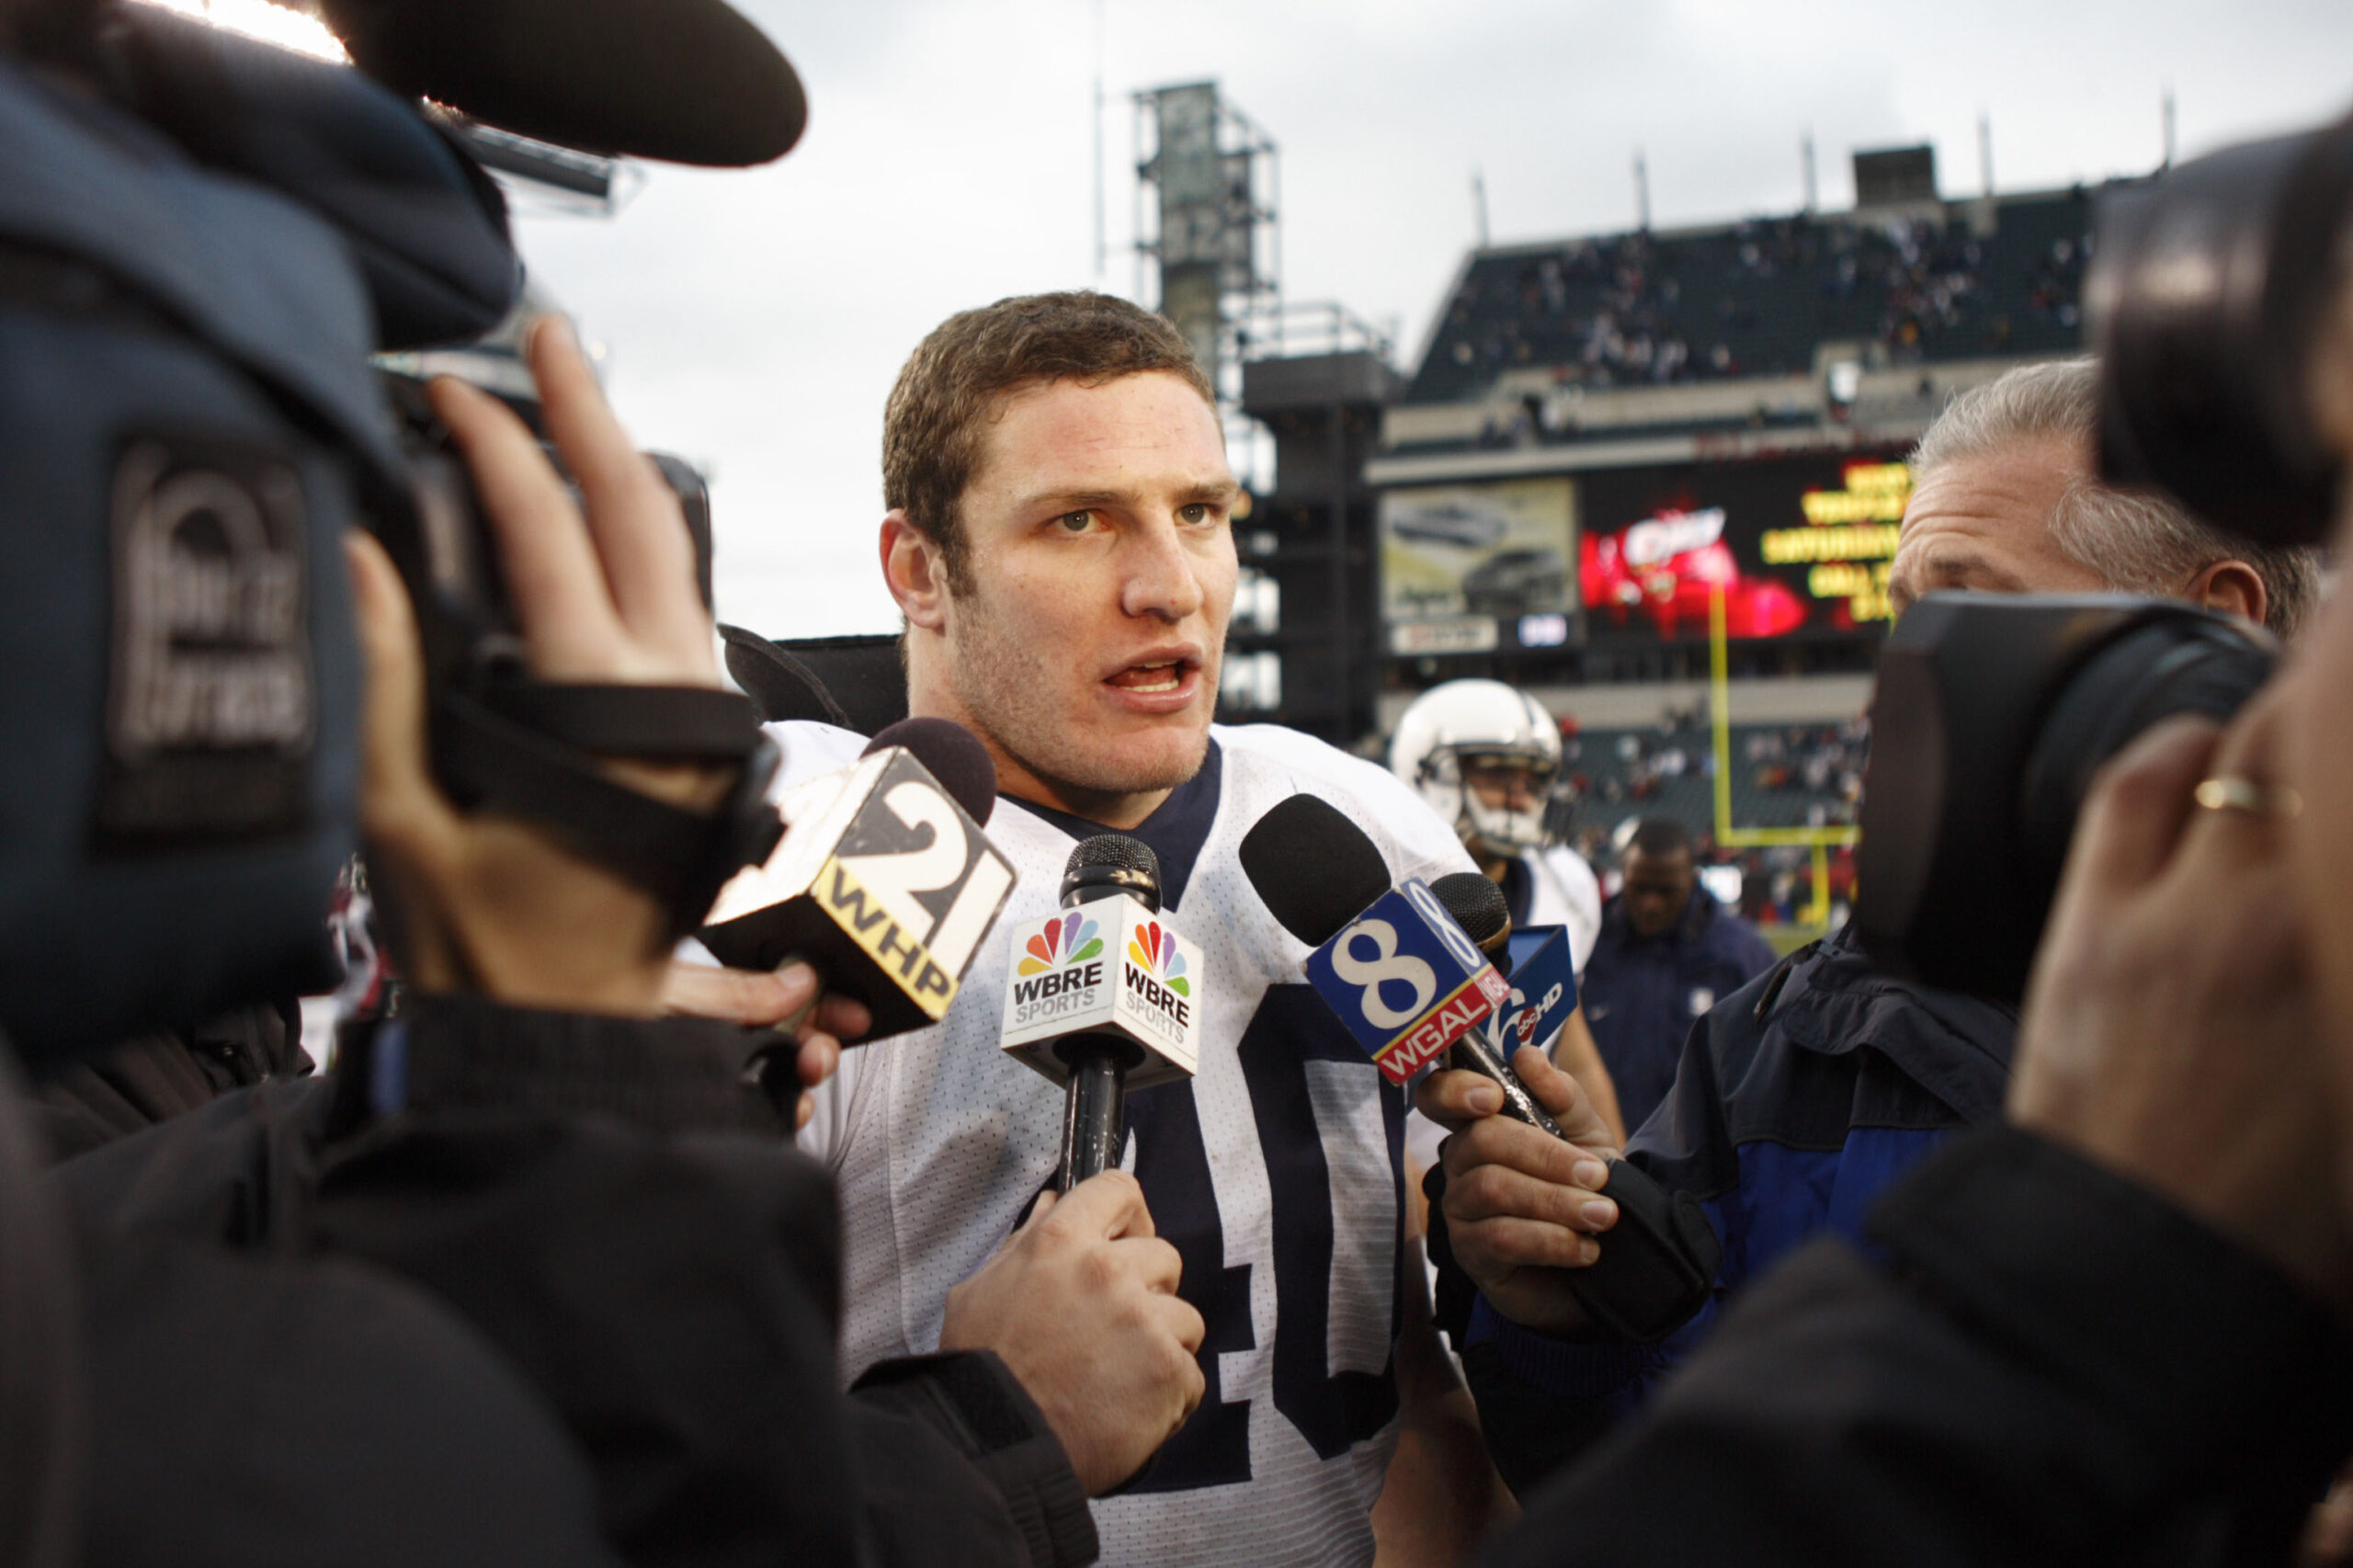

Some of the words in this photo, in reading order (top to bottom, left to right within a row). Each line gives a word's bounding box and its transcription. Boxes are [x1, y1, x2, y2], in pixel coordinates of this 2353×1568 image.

[829, 867, 950, 998] WHP
[1408, 881, 1481, 967] 8
[1014, 962, 1103, 1006] WBRE
[1015, 988, 1096, 1025] SPORTS
[1125, 962, 1190, 1028] WBRE
[1331, 919, 1437, 1029] 8
[1126, 992, 1185, 1045] SPORTS
[1381, 997, 1488, 1076] WGAL
